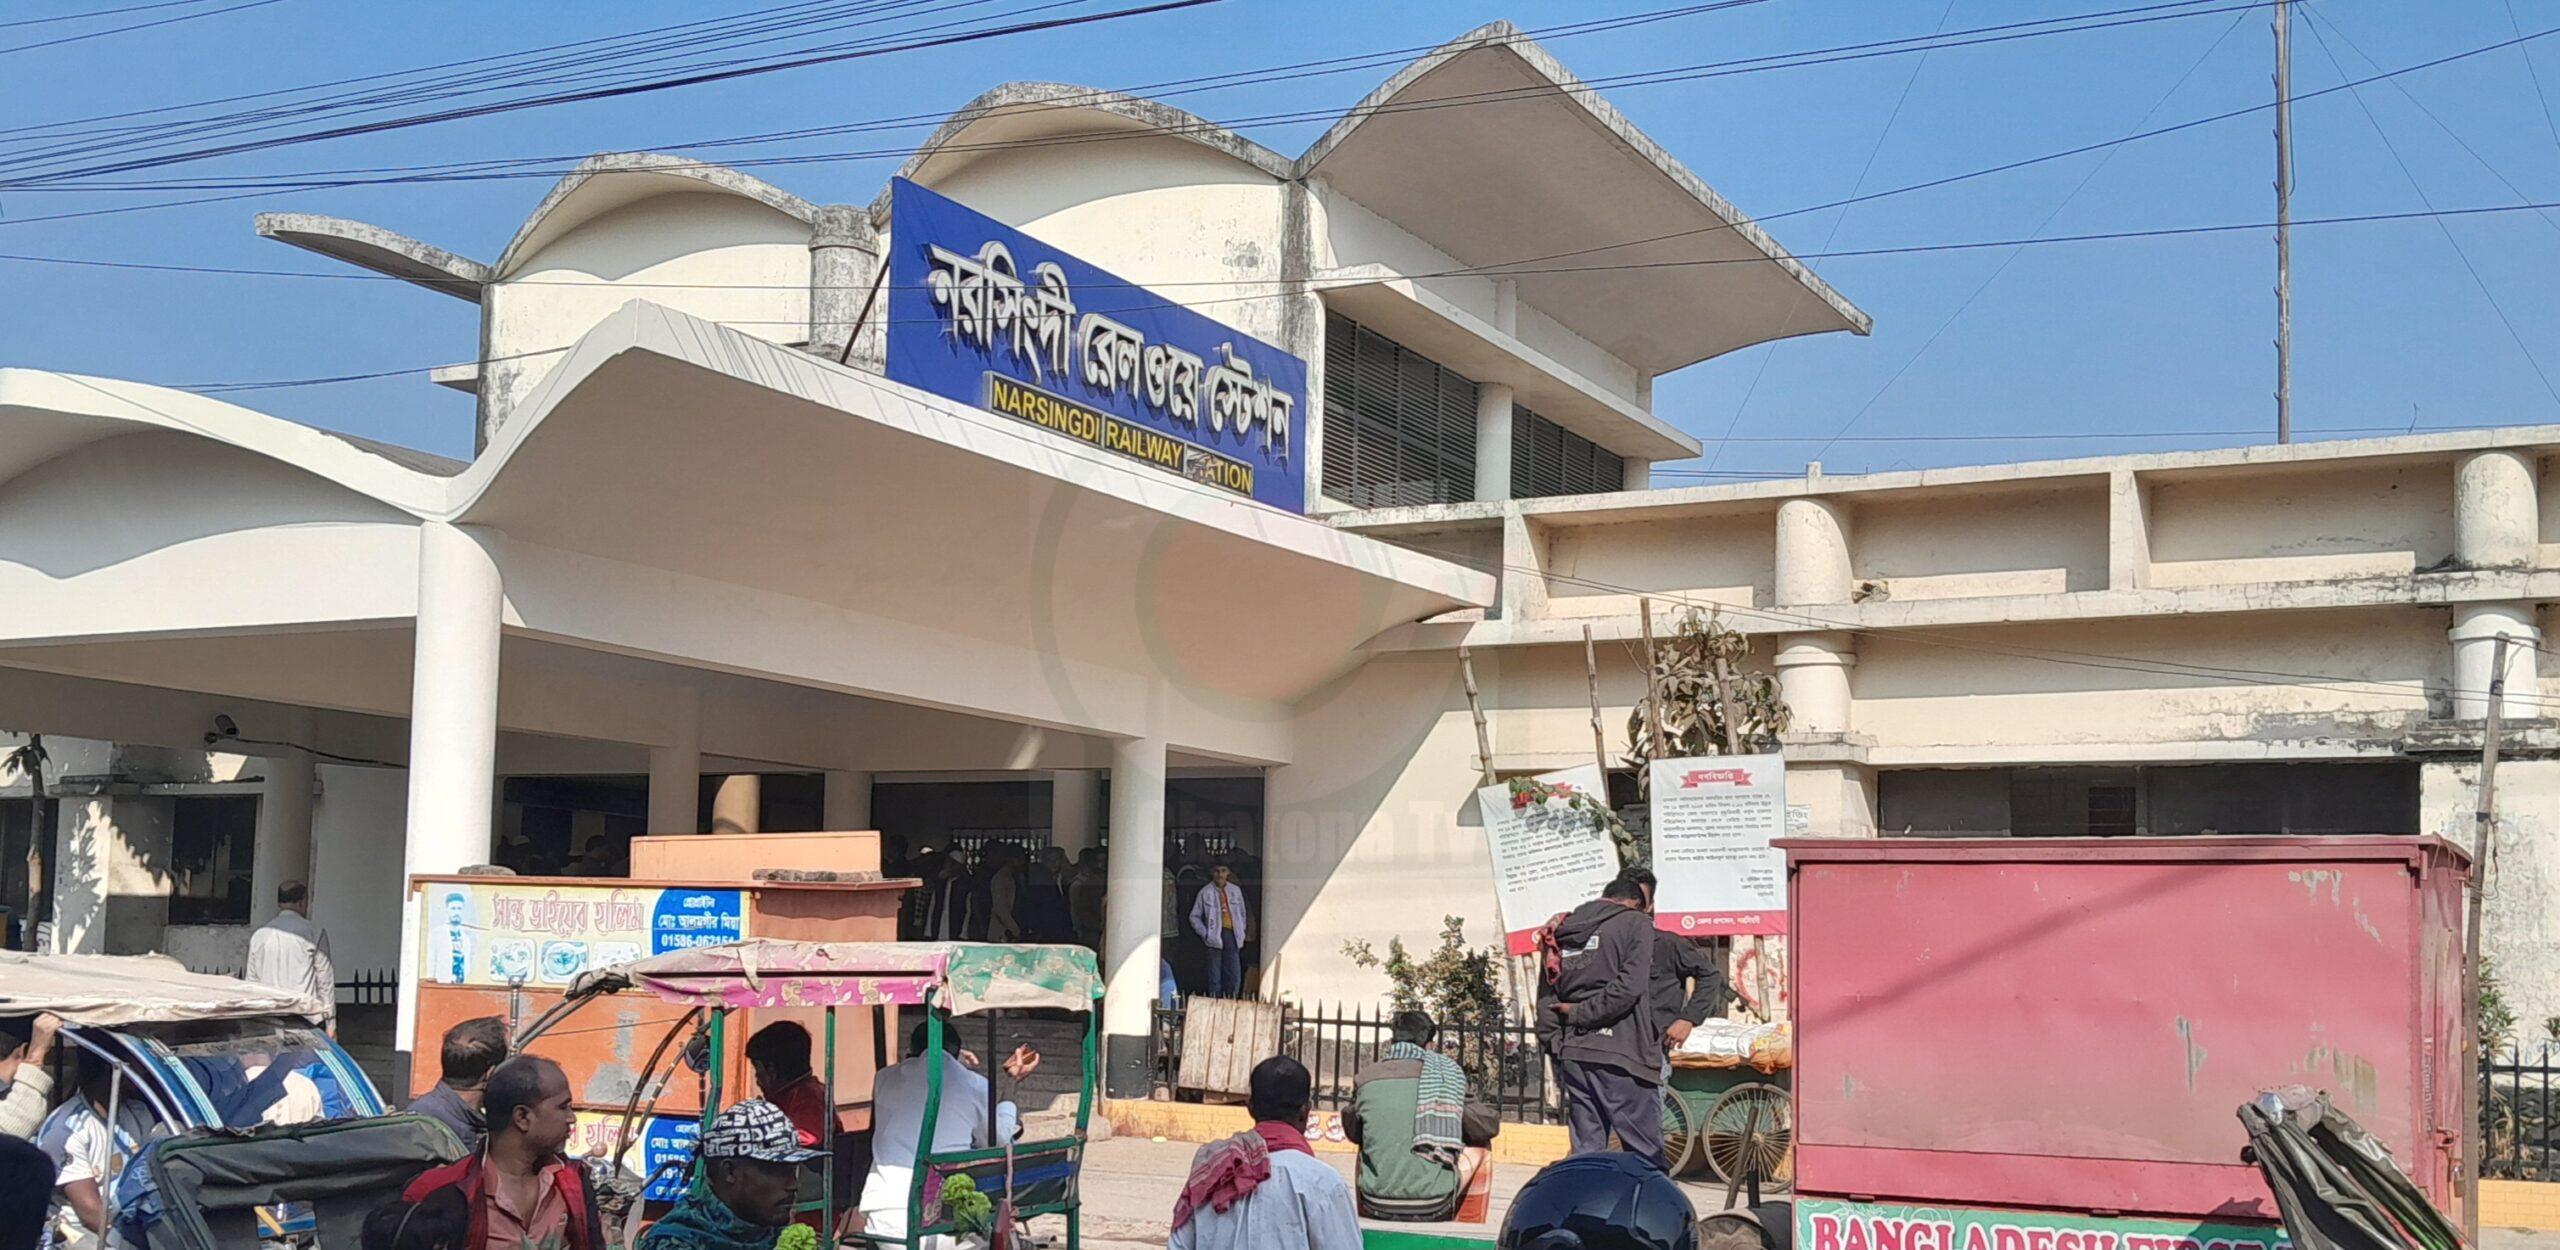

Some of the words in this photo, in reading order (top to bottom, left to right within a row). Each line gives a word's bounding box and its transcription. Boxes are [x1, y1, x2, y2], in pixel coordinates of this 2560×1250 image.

[927, 240, 1076, 384] নরসিংদী
[1205, 342, 1294, 462] স্টেশন
[993, 379, 1100, 445] NARSINGDI
[1105, 421, 1183, 469] RAILWAY
[1199, 452, 1252, 493] ATION
